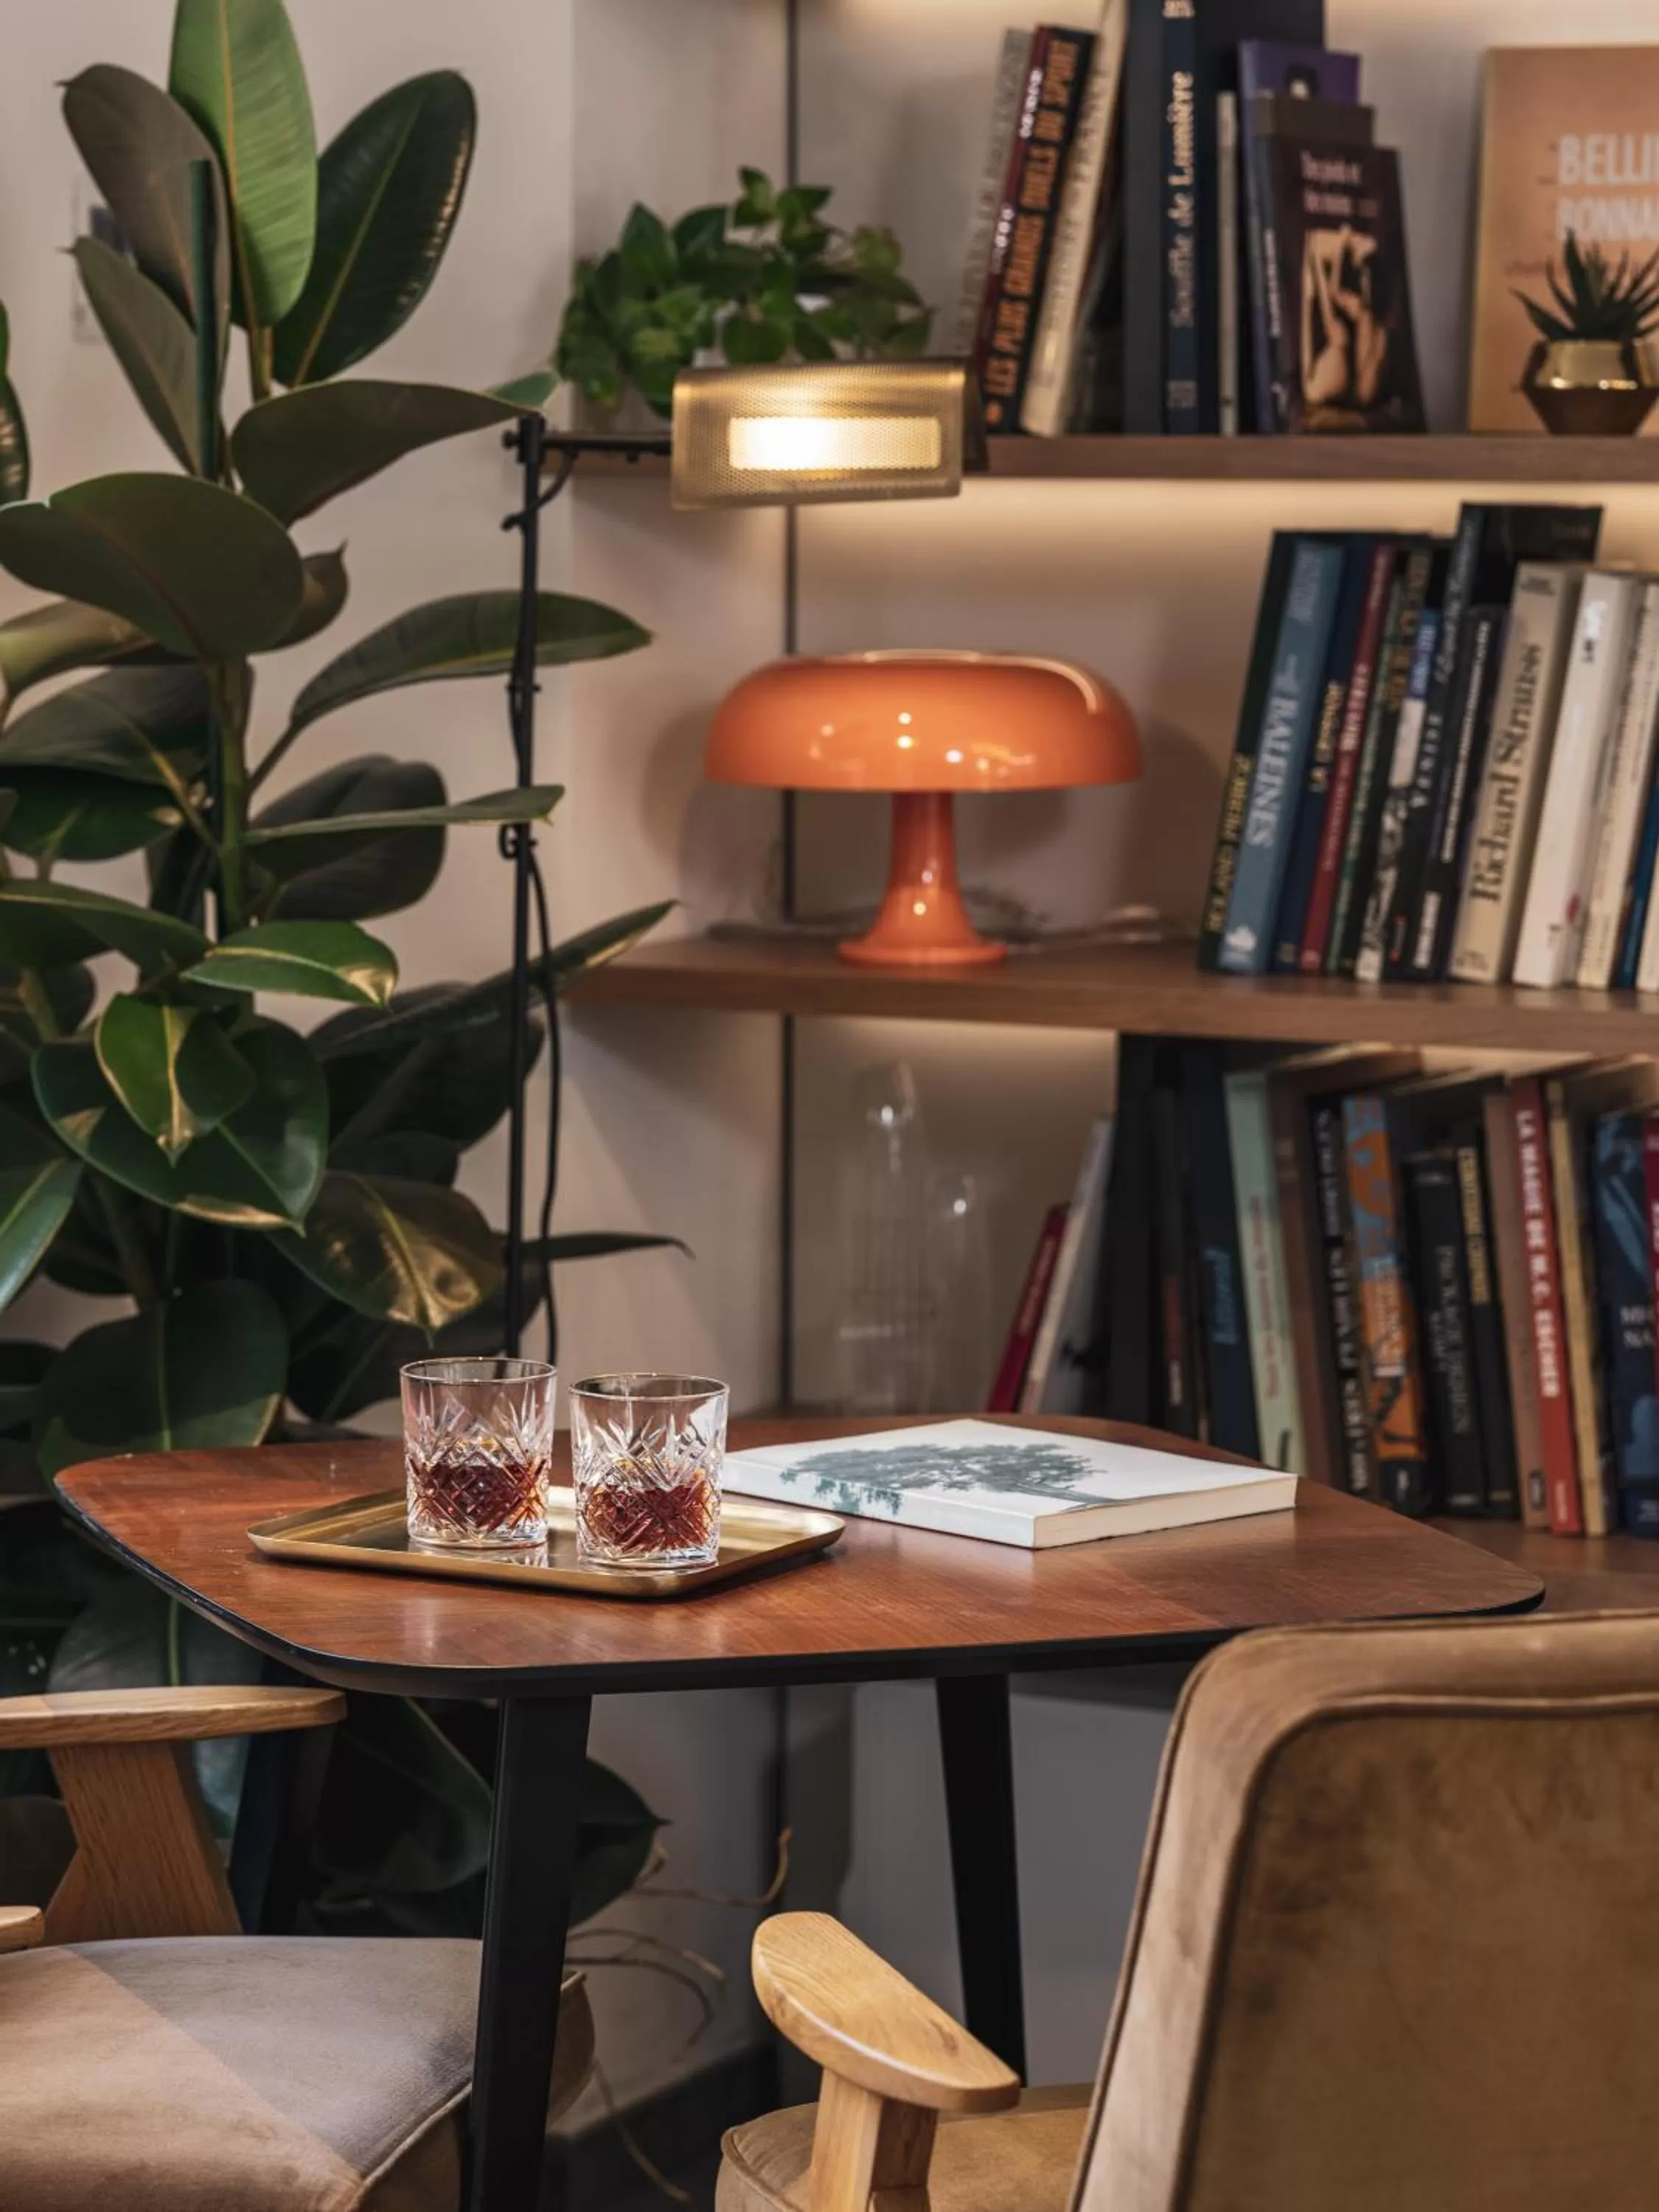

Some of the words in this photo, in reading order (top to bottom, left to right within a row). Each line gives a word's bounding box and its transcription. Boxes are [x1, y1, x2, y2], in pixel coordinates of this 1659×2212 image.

[1167, 191, 1194, 227] de
[1494, 642, 1544, 765] Strauss
[1470, 768, 1521, 904] Richard
[1515, 1109, 1536, 1140] LA
[1520, 1141, 1543, 1215] MAGIE
[1525, 1217, 1548, 1248] DE
[1534, 1308, 1560, 1398] ESCHER
